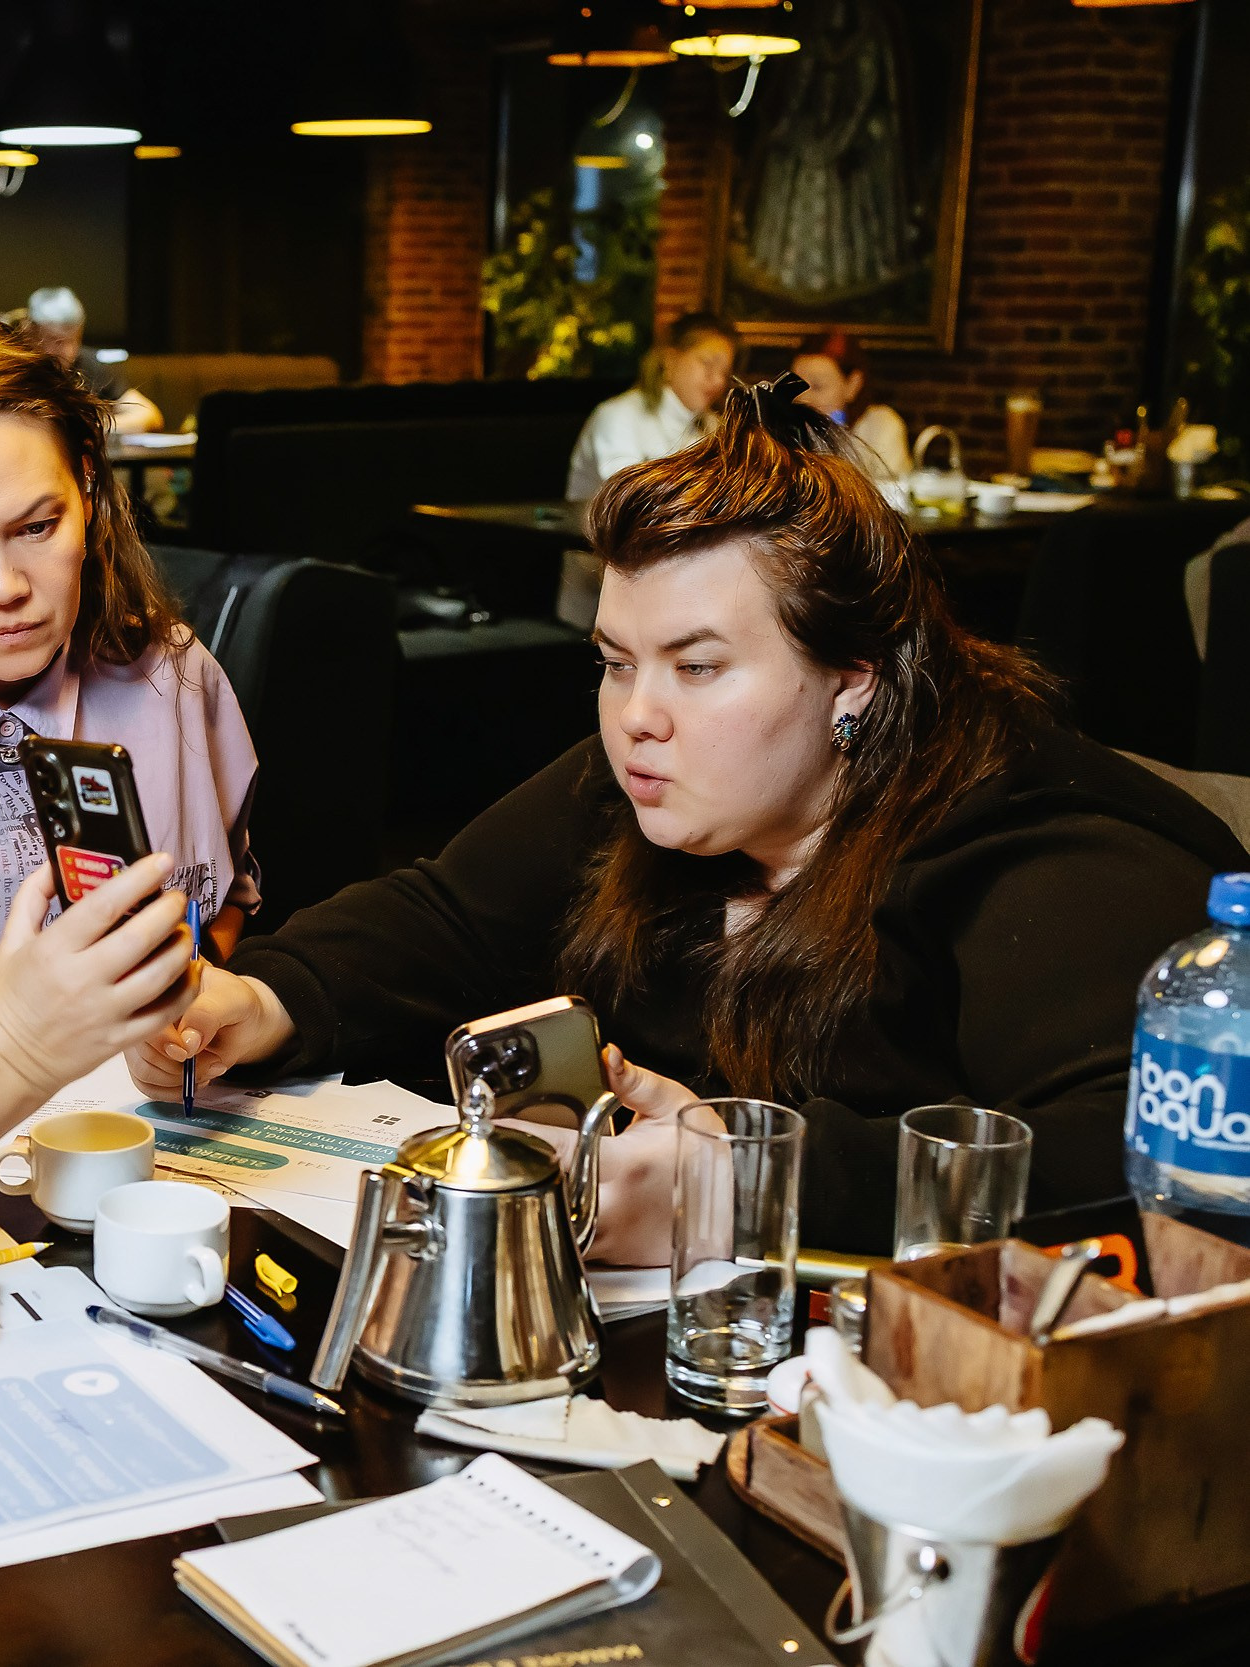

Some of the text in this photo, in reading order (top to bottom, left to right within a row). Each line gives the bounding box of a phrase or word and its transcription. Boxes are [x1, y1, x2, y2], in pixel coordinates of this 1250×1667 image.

[1141, 1053, 1225, 1110] bon
[171, 1112, 250, 1133] accidentlly
[251, 1129, 261, 1137] it
[263, 1124, 394, 1155] typed in my pocket.
[265, 1132, 302, 1144] mind,
[304, 1141, 343, 1152] never
